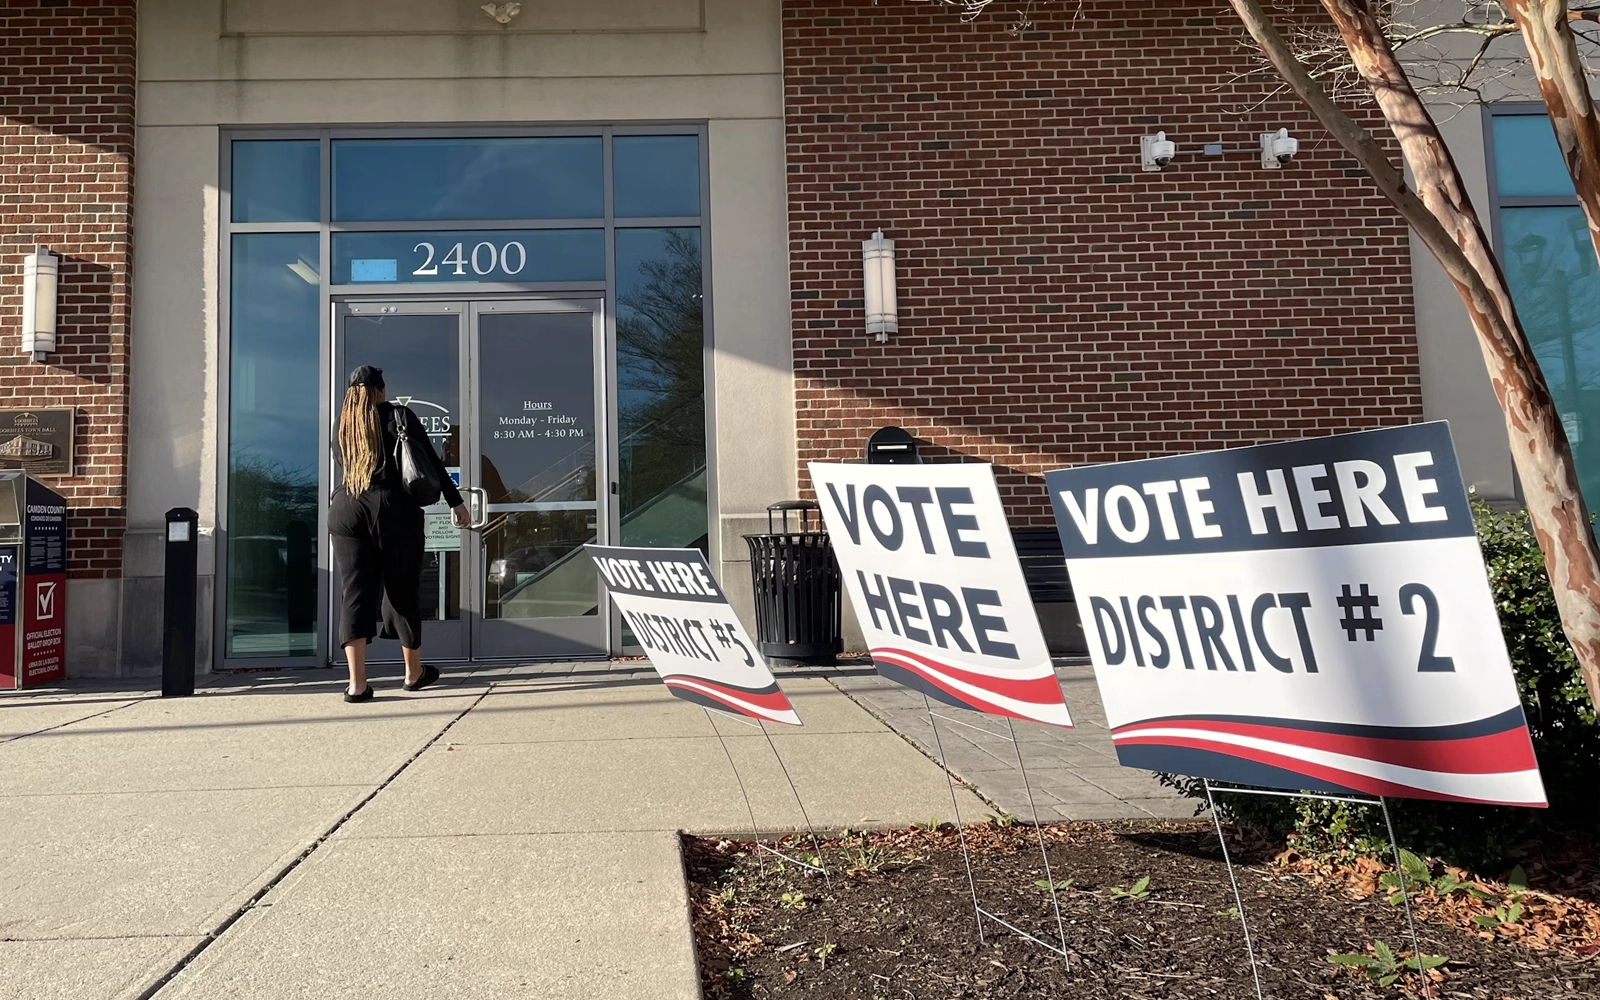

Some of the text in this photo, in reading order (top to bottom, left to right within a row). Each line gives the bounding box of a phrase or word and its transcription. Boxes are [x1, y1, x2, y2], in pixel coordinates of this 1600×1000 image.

[412, 241, 526, 276] 2400
[523, 400, 553, 410] Hours
[419, 416, 451, 433] EES
[493, 430, 515, 439] 8:30
[517, 430, 535, 439] AM
[544, 429, 566, 438] 4:30
[568, 428, 584, 437] PM
[499, 415, 537, 427] Monday
[547, 414, 577, 426] Friday
[27, 505, 66, 514] CAMDEN COUNTY
[1059, 450, 1448, 545] VOTE HERE
[825, 482, 991, 559] VOTE
[592, 556, 718, 597] VOTE HERE
[856, 569, 1021, 660] HERE
[26, 628, 62, 640] OFFICIAL ELECTION
[27, 640, 43, 650] BALLOT
[626, 609, 755, 668] DISTRICT #5
[1089, 591, 1319, 674] DISTRICT
